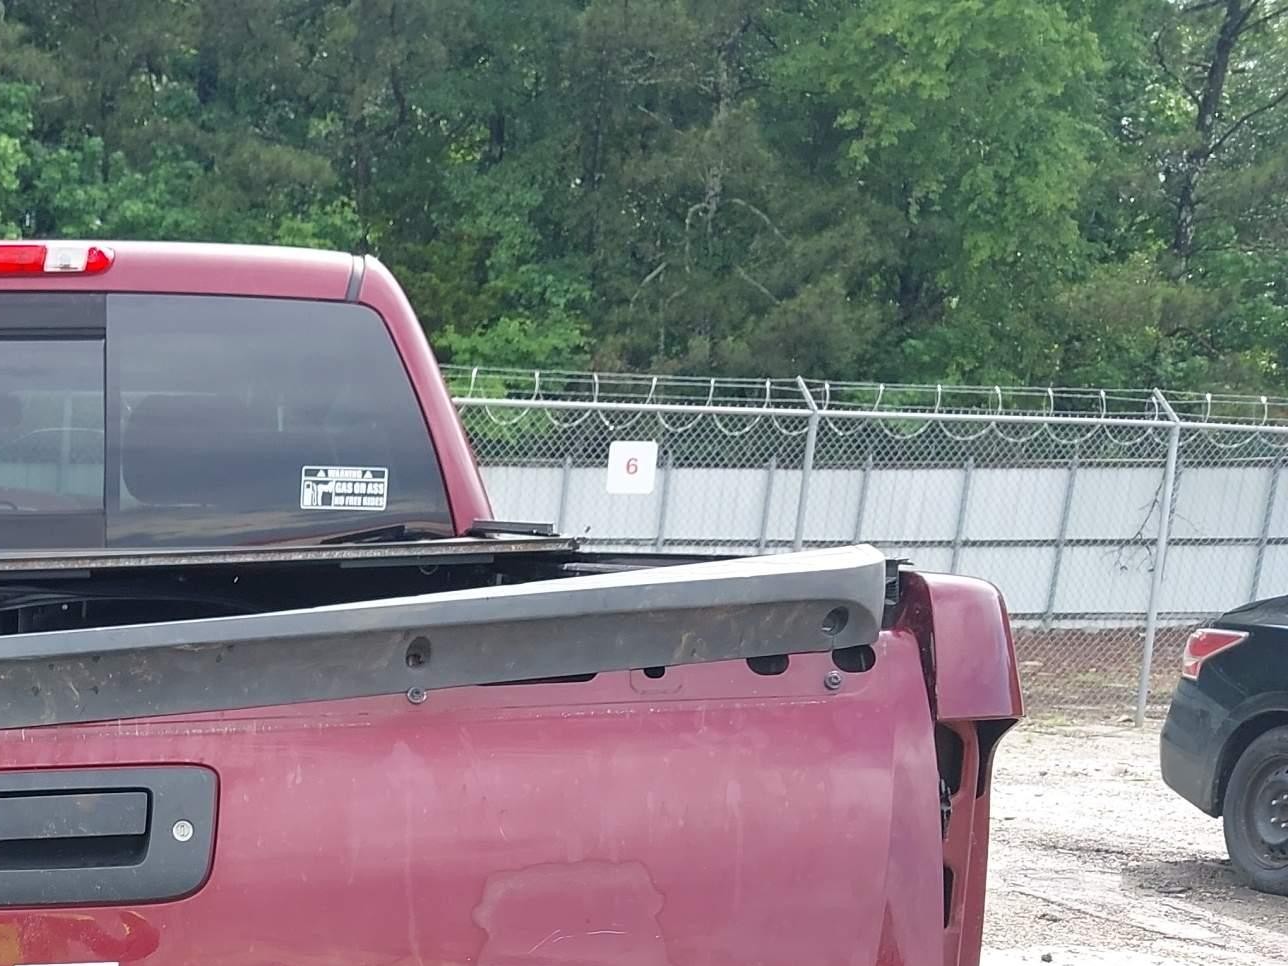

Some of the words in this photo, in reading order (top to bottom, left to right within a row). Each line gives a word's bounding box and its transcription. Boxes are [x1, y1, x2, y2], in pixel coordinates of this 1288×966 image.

[626, 457, 638, 475] 6
[335, 481, 352, 494] GAS
[353, 482, 367, 495] OR
[367, 482, 384, 496] ASS
